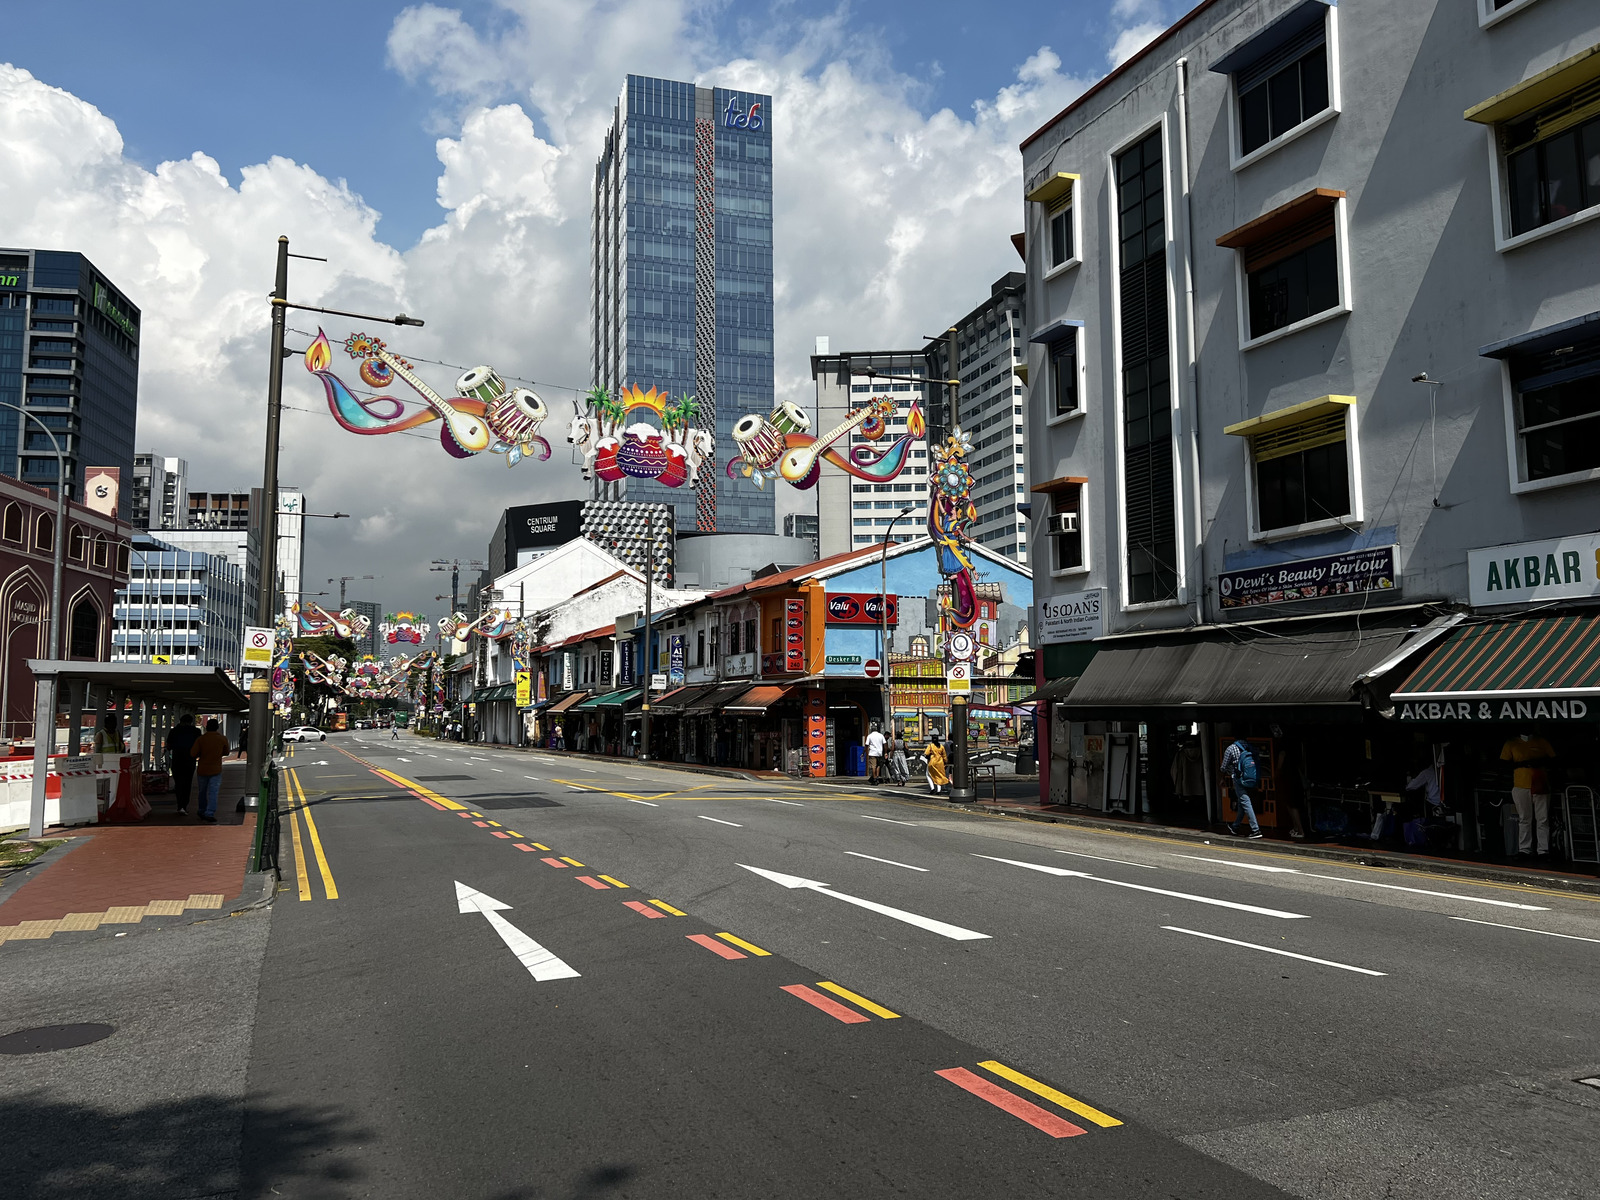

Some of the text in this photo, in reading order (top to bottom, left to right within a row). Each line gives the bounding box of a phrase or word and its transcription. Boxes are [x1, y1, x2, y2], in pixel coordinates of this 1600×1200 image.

[527, 516, 558, 526] CENTRIUM
[530, 524, 556, 534] SQUARE
[1235, 572, 1275, 590] Dewi's
[1278, 567, 1327, 584] Beauty
[1330, 558, 1389, 577] Parlour
[1487, 550, 1581, 592] AKBAR
[673, 647, 683, 655] A1
[1400, 700, 1588, 720] AKBAR & ANAND
